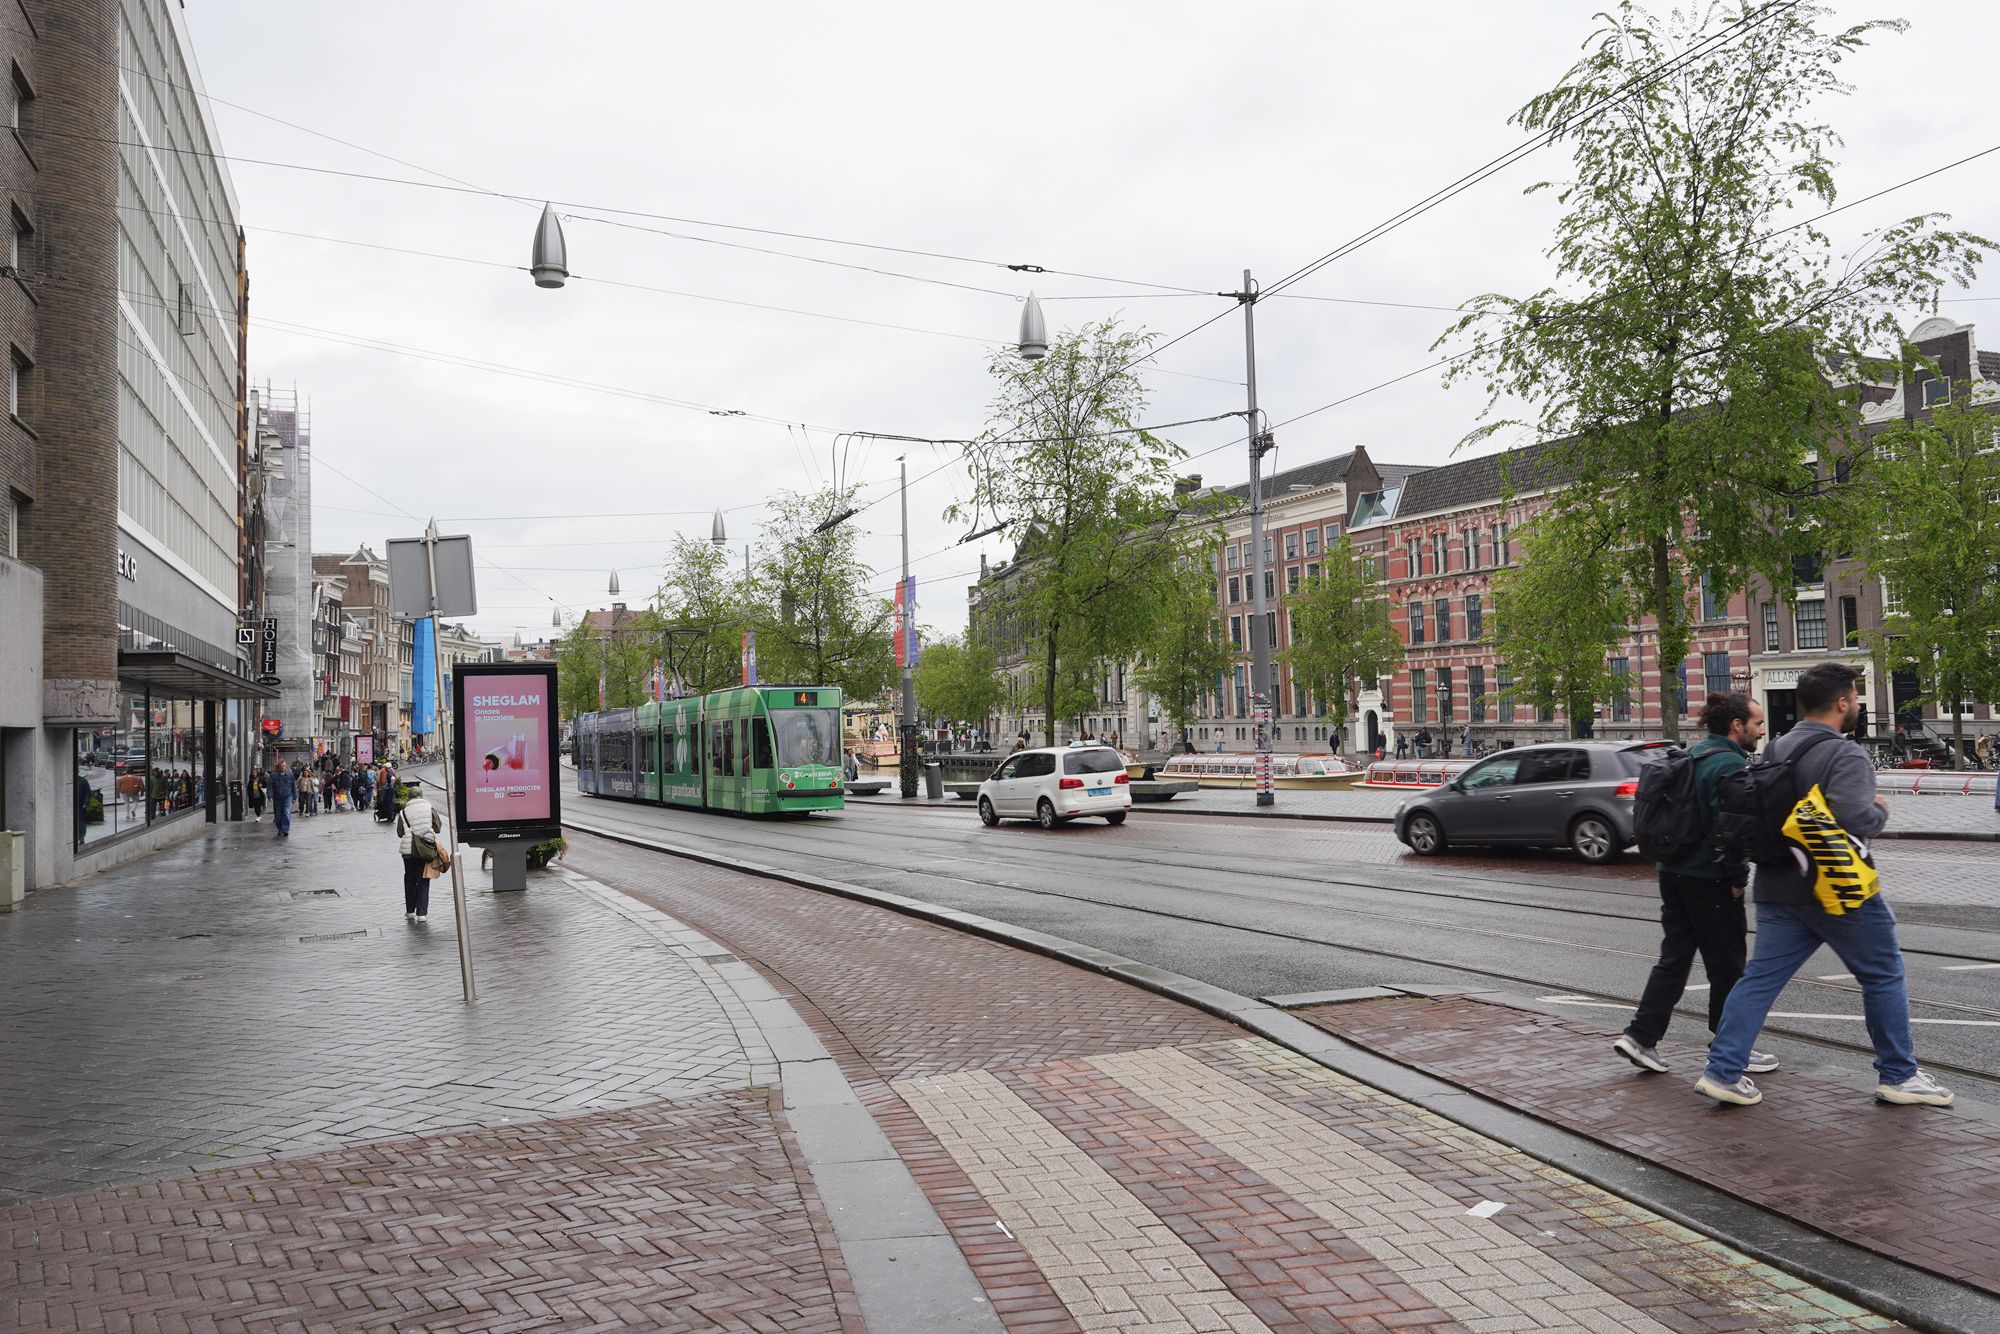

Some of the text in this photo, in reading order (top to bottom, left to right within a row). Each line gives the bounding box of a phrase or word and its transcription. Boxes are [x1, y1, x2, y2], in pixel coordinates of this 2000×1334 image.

[264, 619, 276, 673] HOTEL
[473, 695, 540, 706] SHEGLAM
[801, 692, 806, 704] 4
